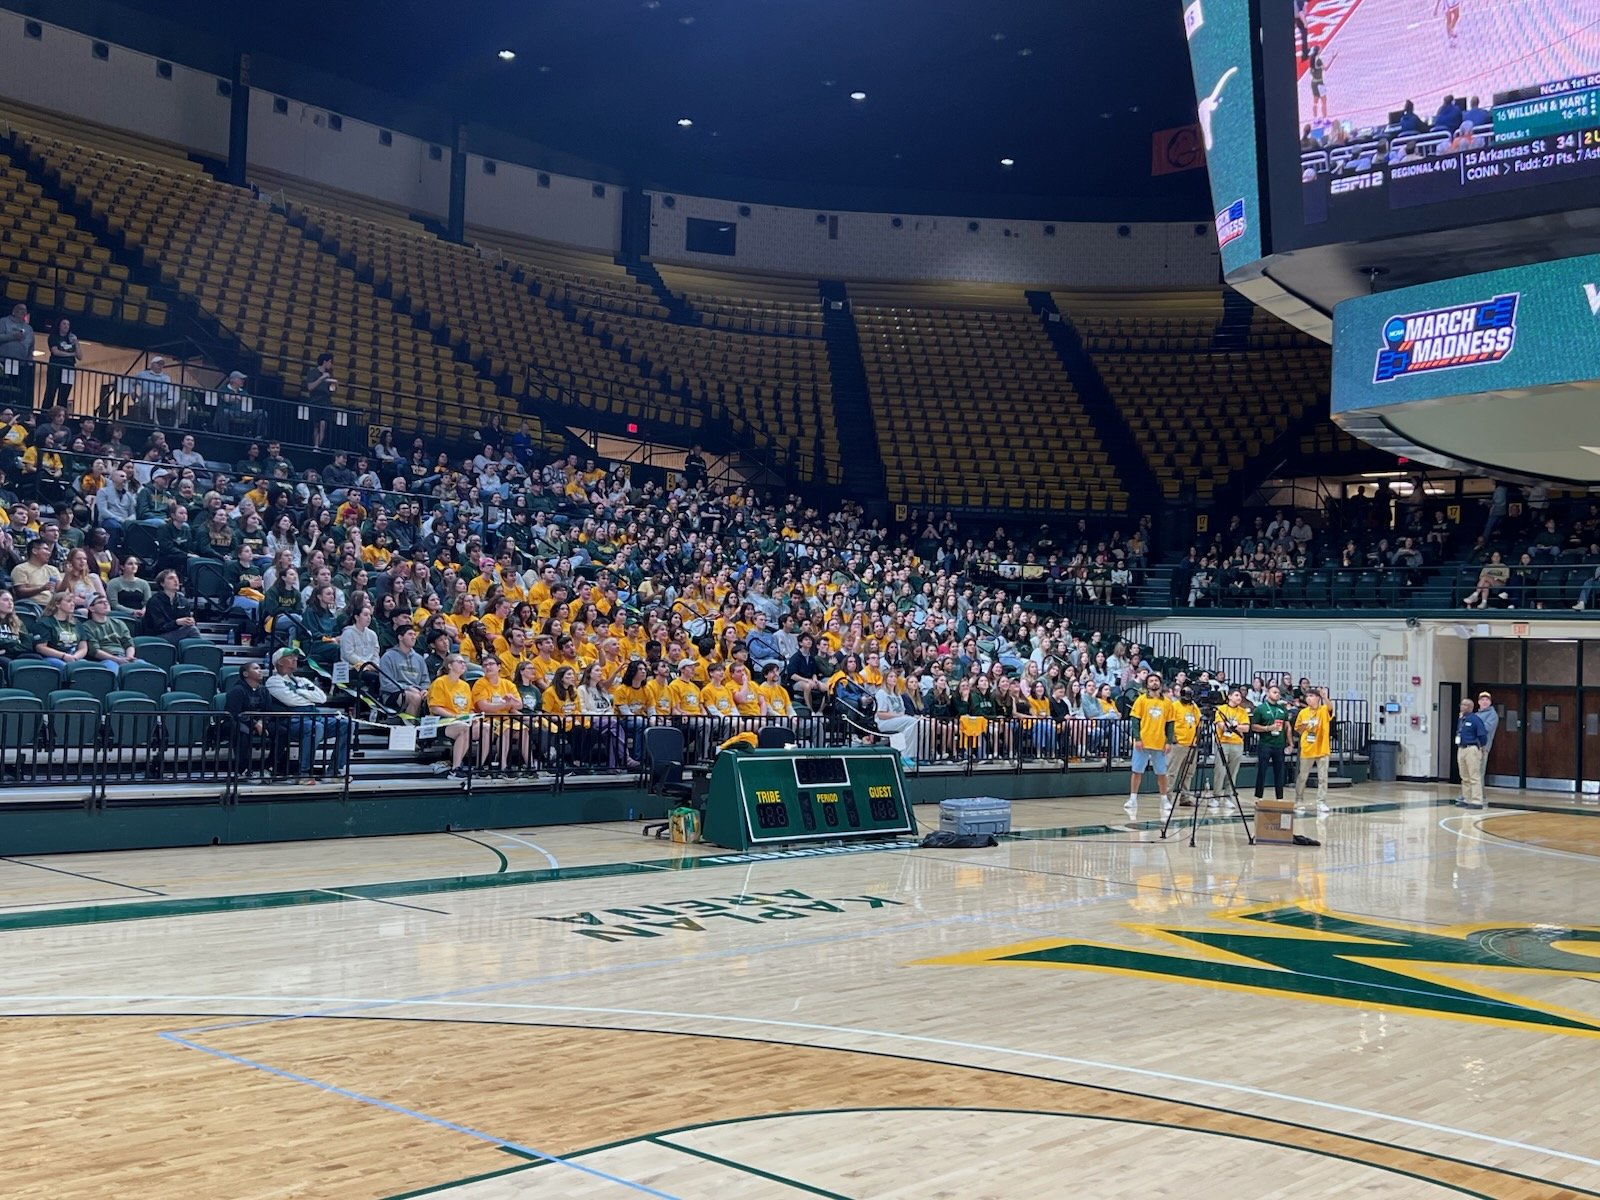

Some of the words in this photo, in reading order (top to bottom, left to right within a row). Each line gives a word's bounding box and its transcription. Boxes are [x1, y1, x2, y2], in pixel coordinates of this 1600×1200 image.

[1540, 81, 1570, 95] NCAA
[1571, 78, 1586, 89] 1st
[1496, 110, 1507, 121] 16
[1506, 101, 1548, 120] WILLIAM
[1549, 100, 1557, 111] &
[1559, 94, 1588, 110] MARY
[1561, 106, 1588, 120] 16-18
[1465, 153, 1477, 166] 15
[1478, 145, 1530, 163] Arkansas
[1531, 140, 1545, 153] St
[1556, 134, 1575, 149] 34
[1390, 162, 1433, 179] REGIONAL
[1433, 160, 1441, 171] 4
[1441, 158, 1457, 171] (W)
[1466, 163, 1499, 181] CONN
[1514, 158, 1541, 172] Fudd:
[1542, 154, 1555, 167] 27
[1556, 152, 1575, 165] Pts,
[1576, 149, 1583, 161] 7
[1330, 170, 1384, 195] ESPN2
[1404, 307, 1478, 342] MARCH
[1411, 326, 1513, 364] MADNESS
[369, 426, 381, 438] 22
[1513, 624, 1526, 634] EXIT
[755, 790, 781, 803] TRIBE
[816, 793, 838, 803] PERIOD
[868, 785, 893, 799] GUEST
[534, 888, 814, 926] ARENA
[571, 895, 905, 943] KAPLAN
